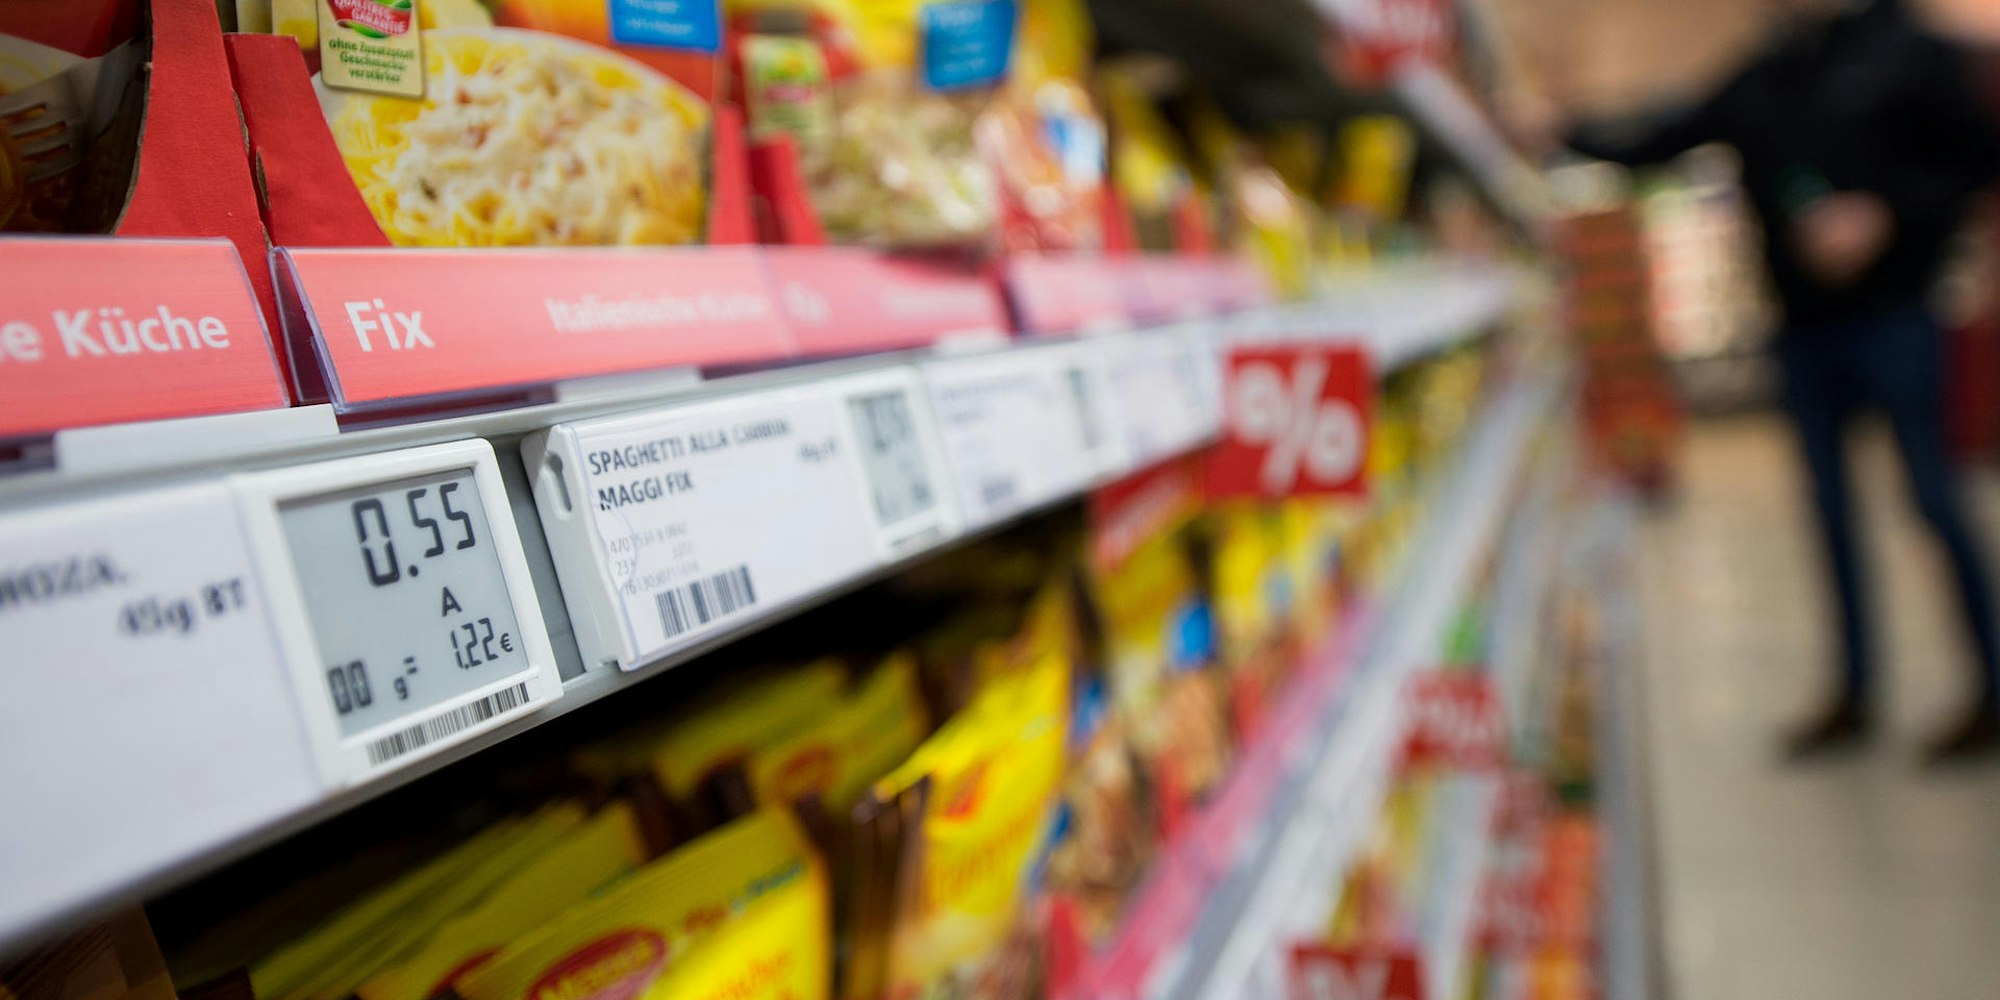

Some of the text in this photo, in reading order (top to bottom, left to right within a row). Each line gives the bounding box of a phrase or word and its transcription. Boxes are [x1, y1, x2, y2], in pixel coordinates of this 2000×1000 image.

[328, 38, 357, 50] ohne
[53, 305, 230, 358] Küche
[344, 298, 435, 352] Fix
[588, 436, 684, 476] SPAGHETTI
[598, 469, 693, 511] MAGGI FIX
[352, 482, 476, 587] 0.55
[203, 576, 245, 616] BT
[441, 586, 463, 617] A
